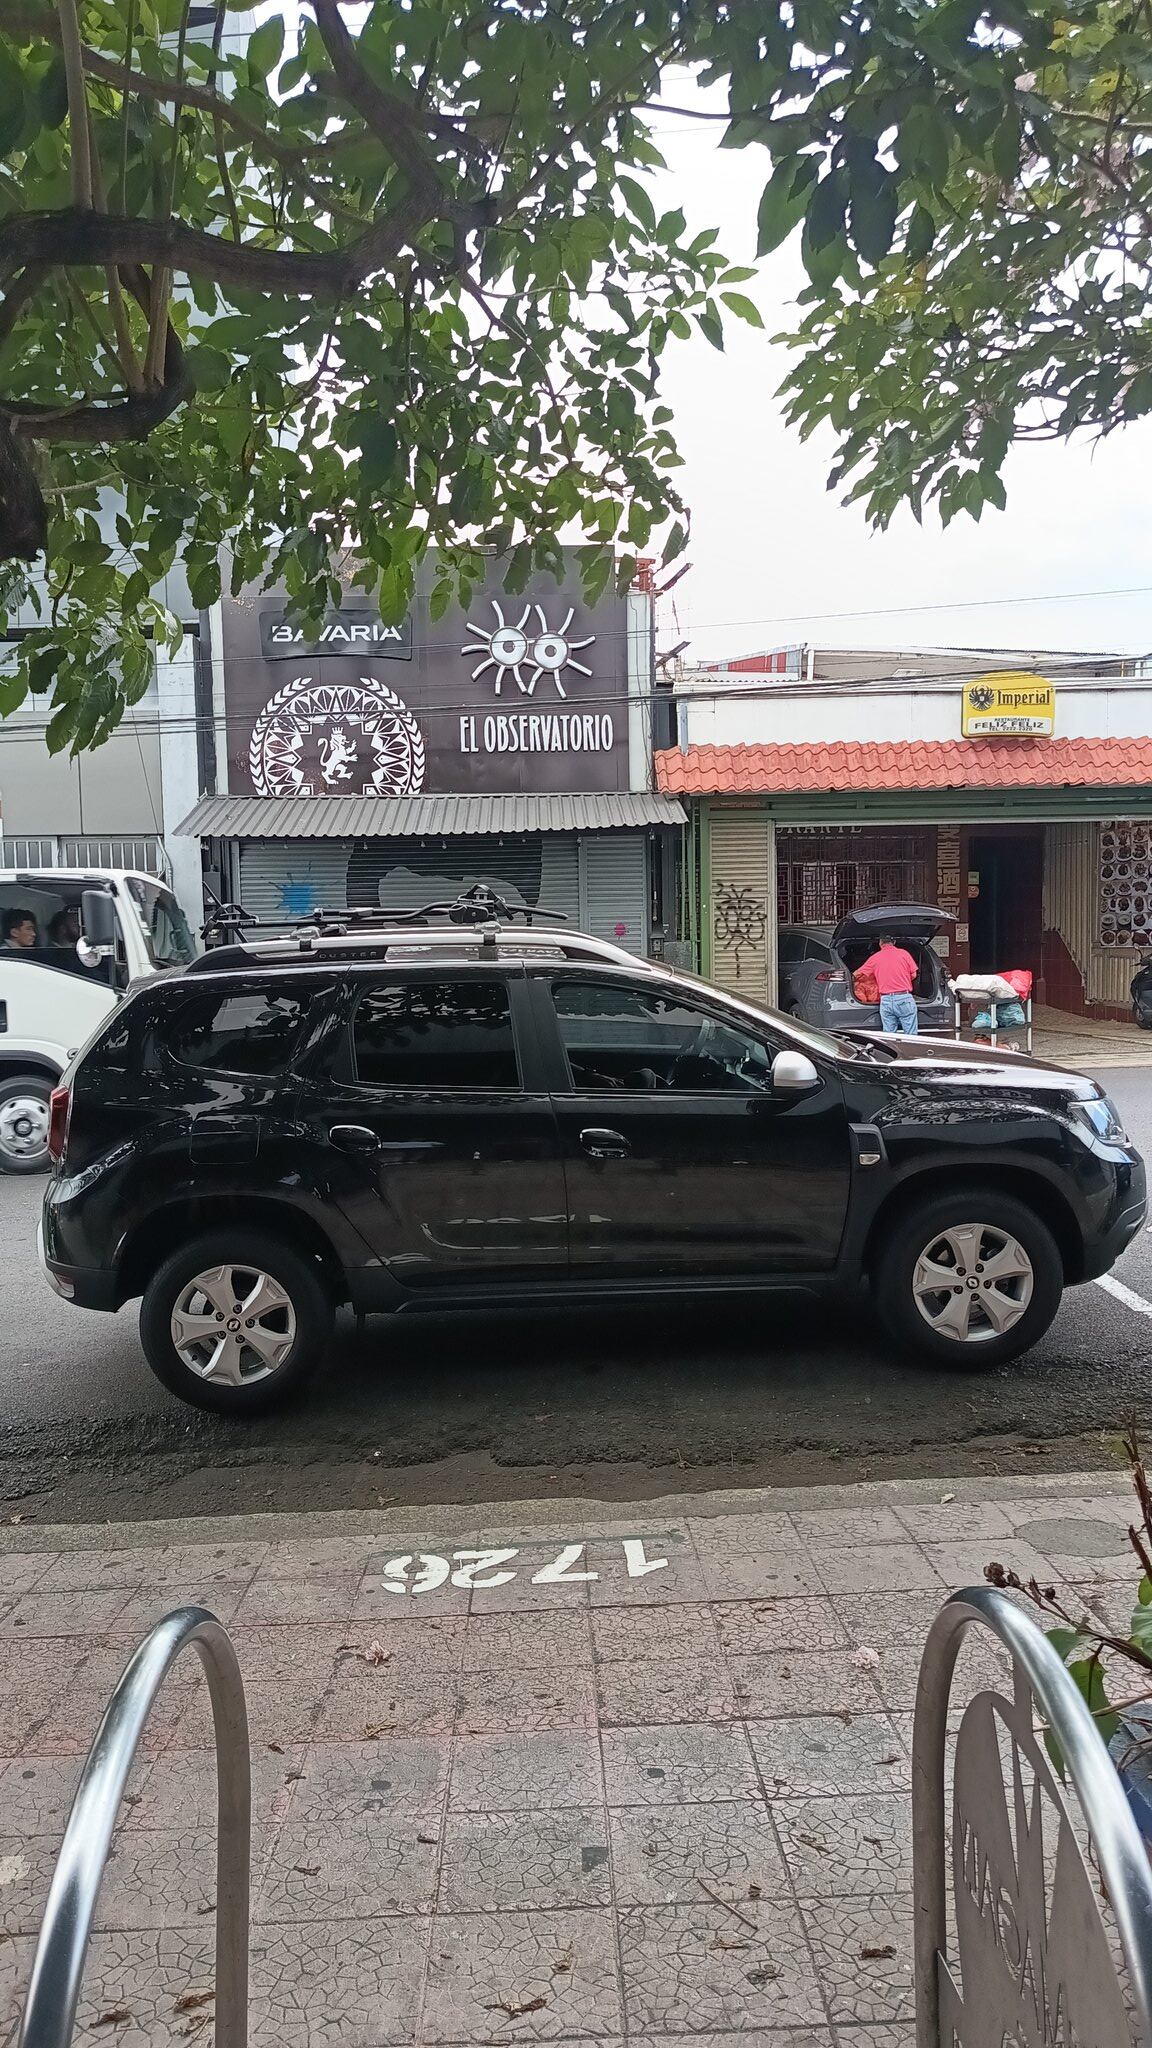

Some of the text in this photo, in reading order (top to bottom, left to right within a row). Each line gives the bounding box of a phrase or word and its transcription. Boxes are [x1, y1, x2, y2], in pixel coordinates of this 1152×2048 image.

[997, 689, 1050, 709] Imperial
[459, 714, 614, 753] EL OBSERVATORIO
[974, 721, 1044, 730] FELIZ FELIZ
[319, 951, 377, 959] DUSTER
[381, 1539, 668, 1594] 1726
